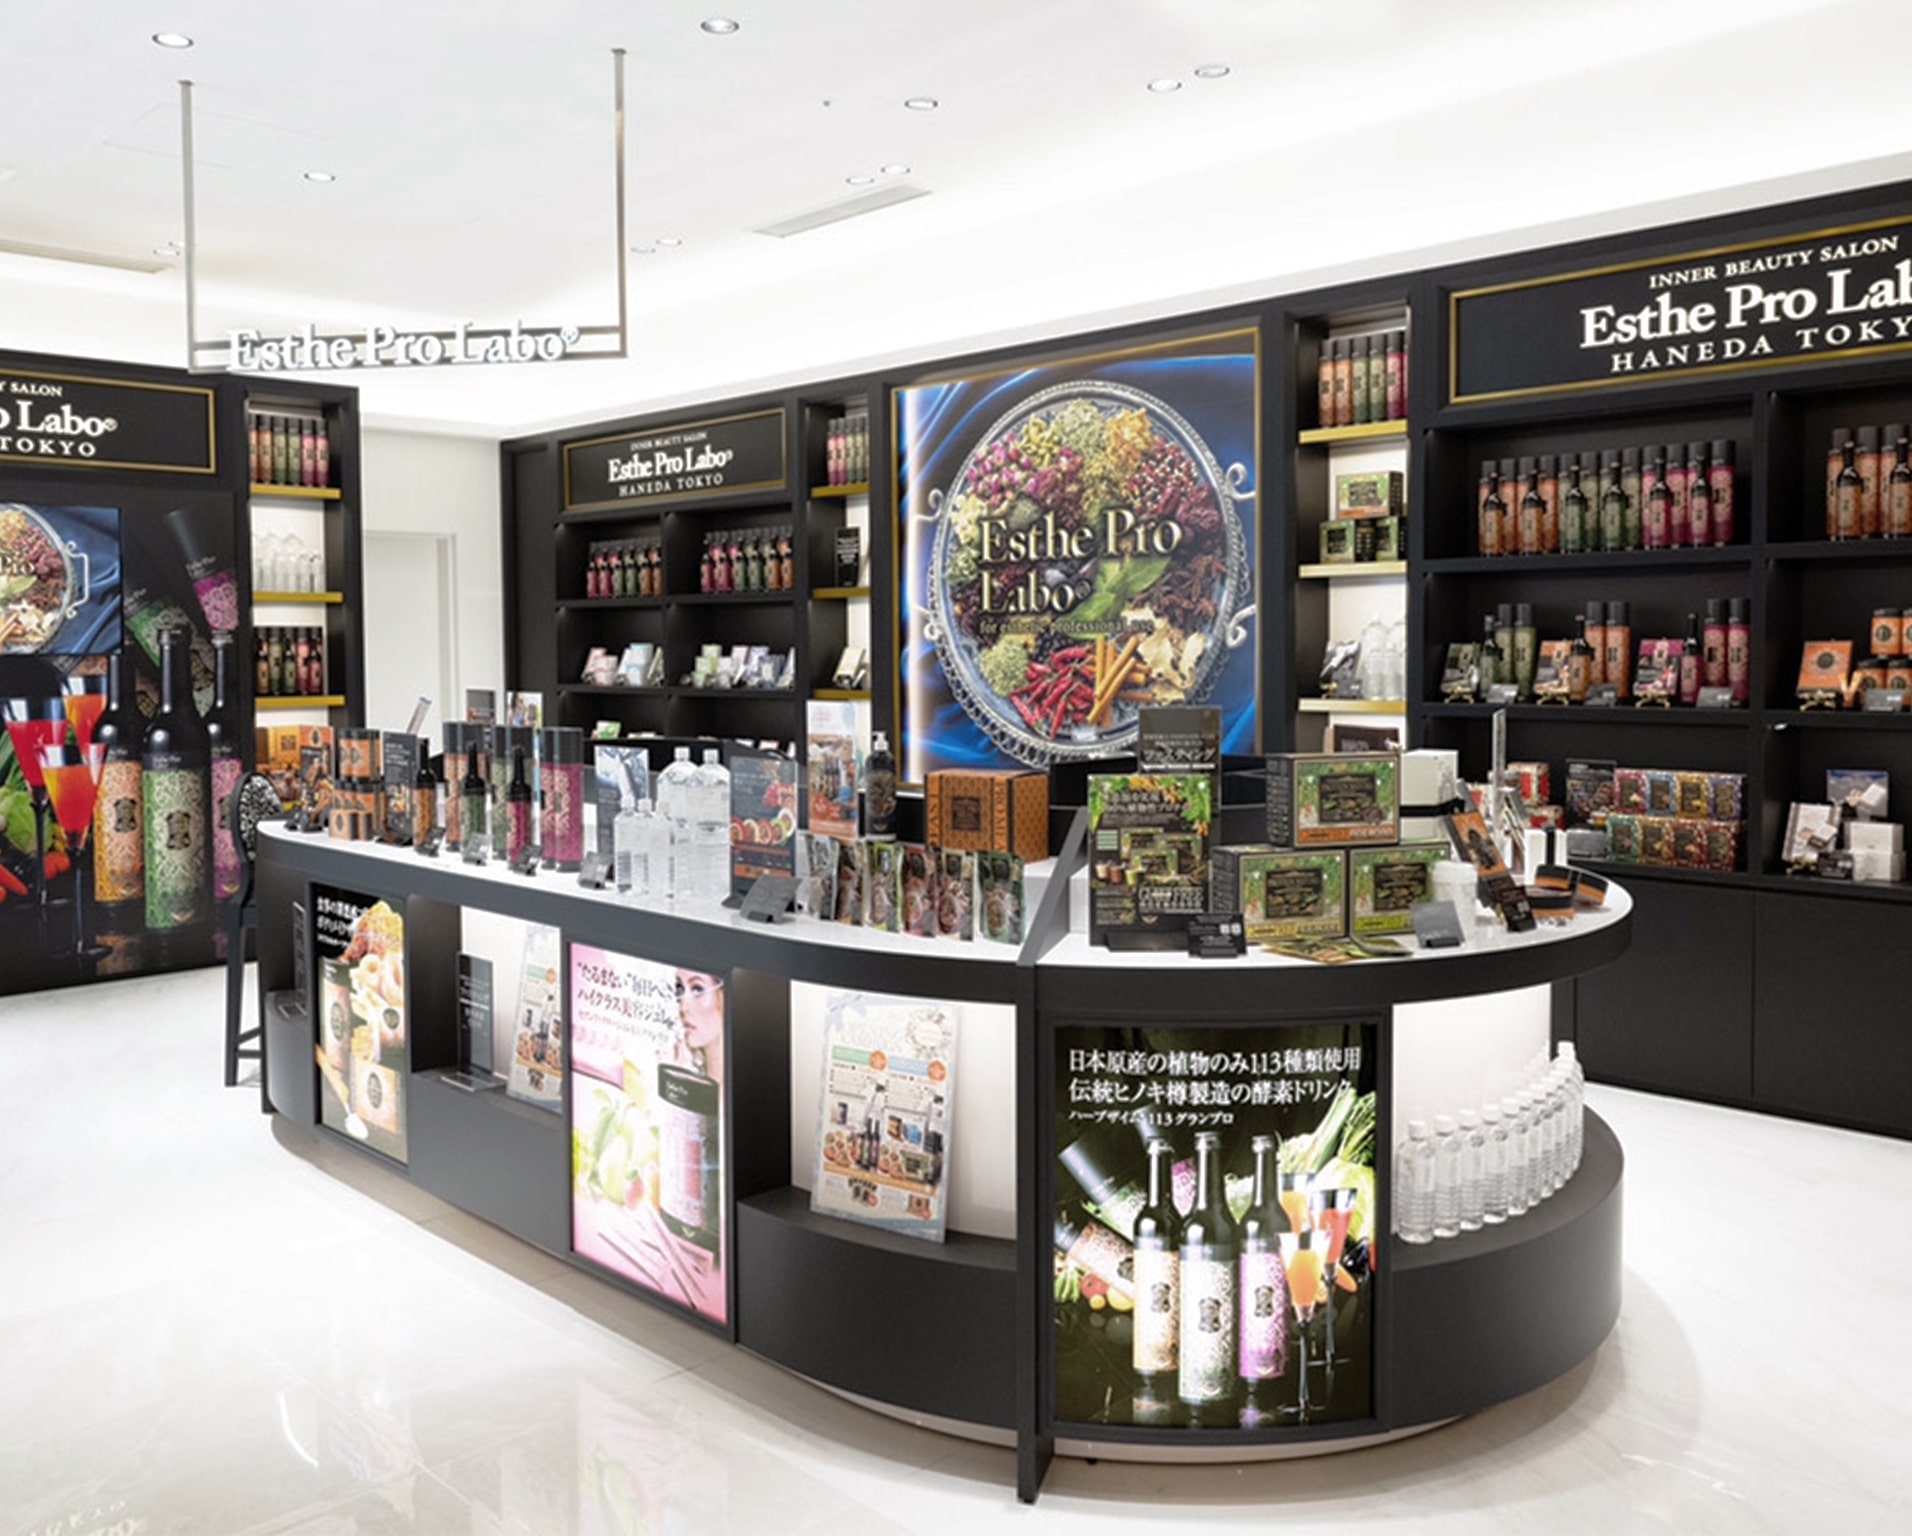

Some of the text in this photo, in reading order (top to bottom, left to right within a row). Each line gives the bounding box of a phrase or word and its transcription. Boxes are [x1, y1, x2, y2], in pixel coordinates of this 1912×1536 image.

[1649, 235, 1899, 289] INNER BEAUTY SALON
[1579, 291, 1717, 349] Esthe
[1724, 282, 1818, 328] Pro
[226, 322, 357, 373] Esthe
[361, 321, 446, 367] Pro
[1610, 334, 1774, 374] HANEDA
[9, 381, 63, 397] SALON
[608, 452, 653, 483] Esthe
[655, 451, 684, 477] Pro
[618, 472, 724, 498] HANEDA TOKYO
[979, 507, 1183, 564] Esthe Pro
